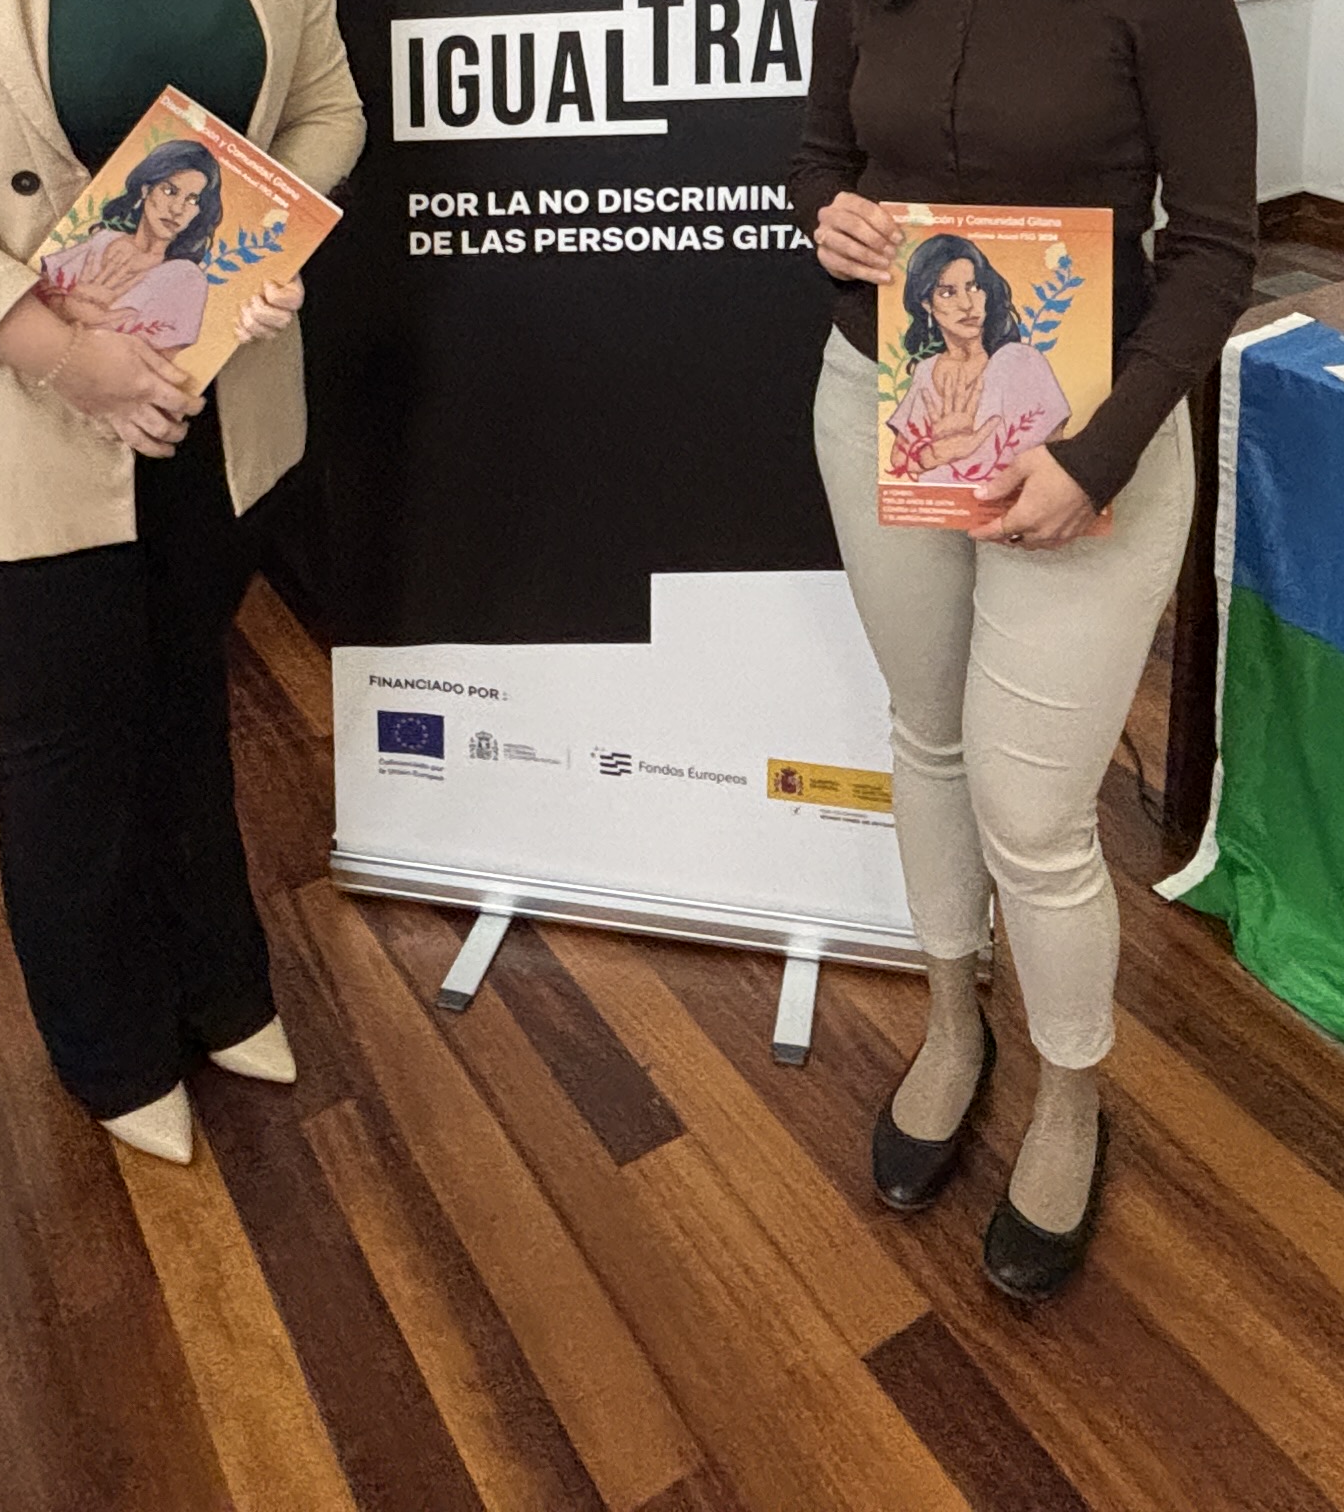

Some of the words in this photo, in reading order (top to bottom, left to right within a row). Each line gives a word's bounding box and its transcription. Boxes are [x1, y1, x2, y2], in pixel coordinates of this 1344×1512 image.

[409, 193, 478, 219] POR
[486, 192, 531, 217] LA
[538, 188, 591, 216] NO
[598, 185, 795, 214] DISCRIMIN
[409, 231, 453, 256] DE
[461, 228, 527, 255] LAS
[534, 224, 725, 254] PERSONAS
[369, 675, 464, 695] FINANCIADO
[639, 761, 684, 778] Fondos
[687, 767, 747, 786] Europeos
